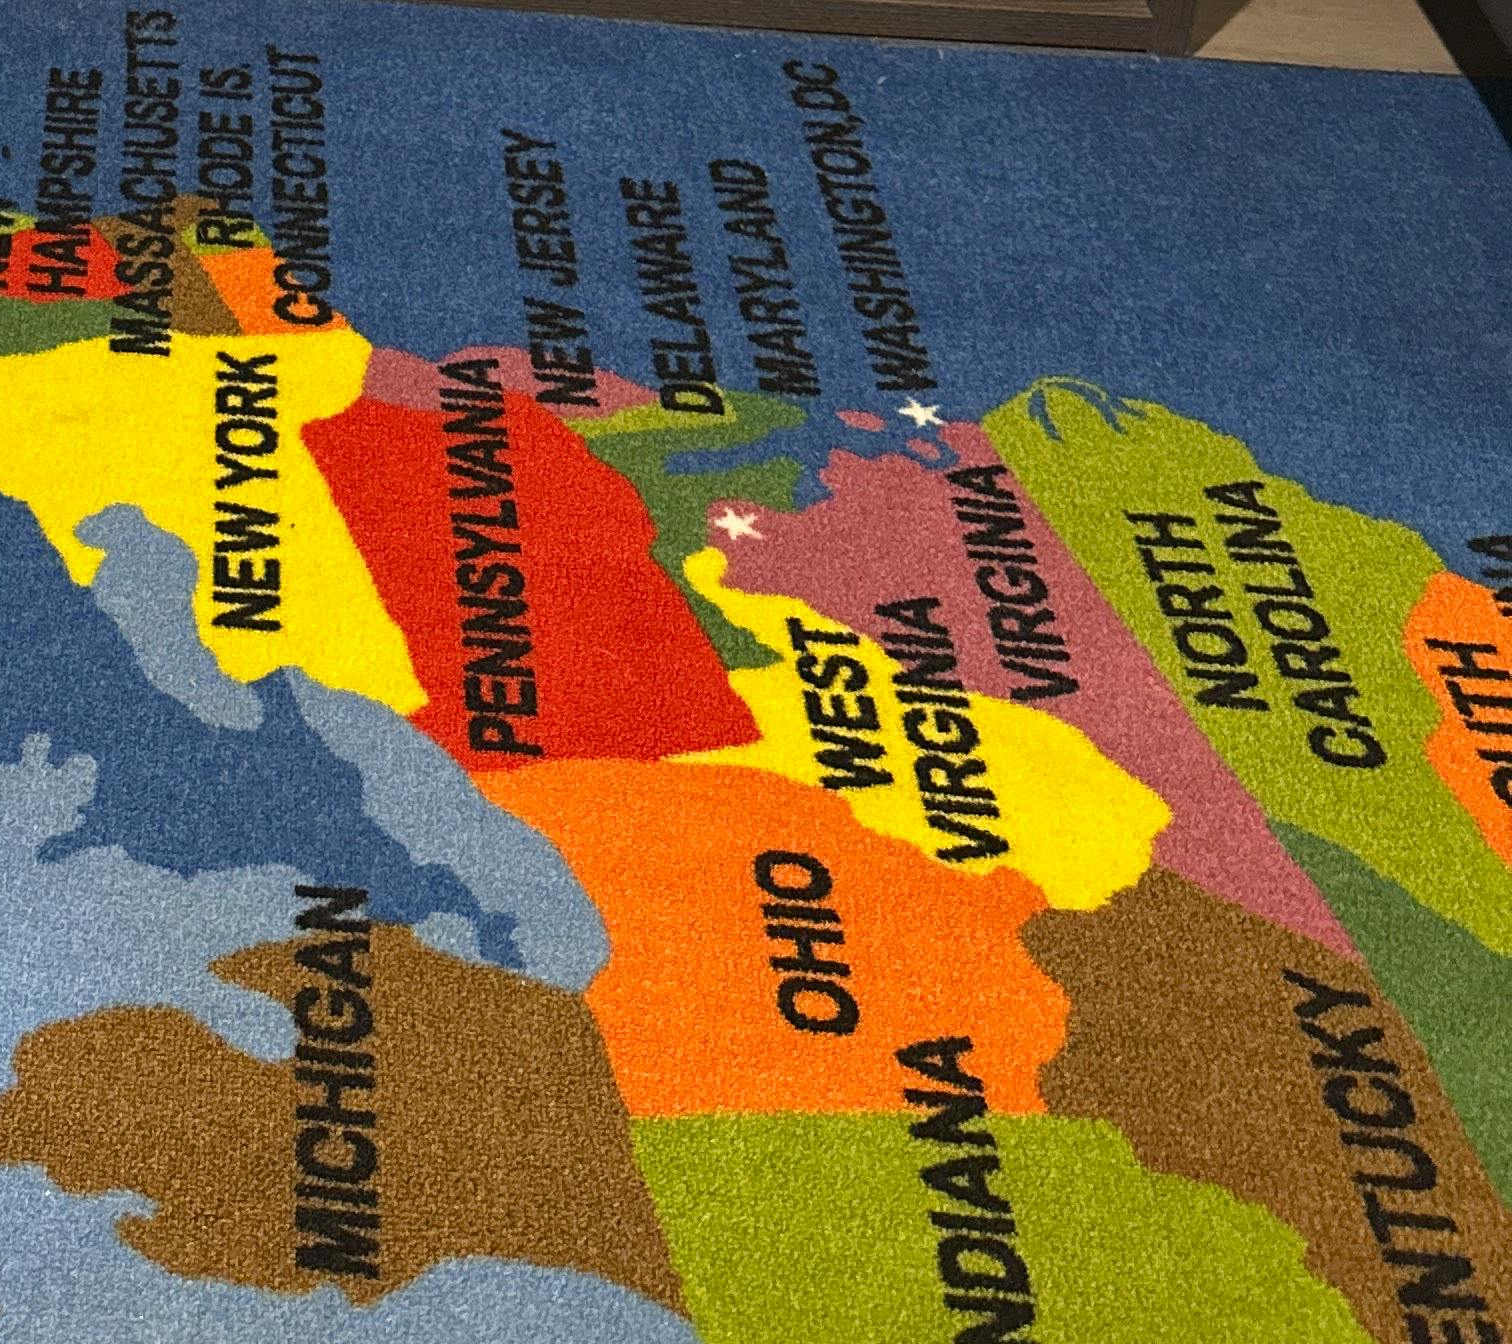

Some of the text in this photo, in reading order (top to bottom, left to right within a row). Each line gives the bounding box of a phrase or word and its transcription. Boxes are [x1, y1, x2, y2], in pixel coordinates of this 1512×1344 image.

[26, 67, 104, 297] HAMPSHIRE
[109, 10, 180, 357] MASSACHUSETTS
[196, 112, 254, 248] RHODE
[266, 43, 333, 326] CONNECTICUT
[501, 127, 600, 408] NEW JERSEY
[619, 176, 725, 416] DELAWARE
[708, 158, 821, 396] MARYLAND
[211, 352, 282, 632] NEW YORK
[439, 357, 544, 758] PENNSYLVANIA
[947, 464, 1081, 703] VIRGINIA
[1124, 510, 1270, 712] NORTH
[1203, 479, 1388, 770] CAROLINA
[786, 617, 894, 791] WEST
[874, 596, 1009, 864] VIRGINIA
[755, 847, 863, 1037] OHIO
[294, 884, 382, 1281] MICHIGAN
[894, 1036, 1037, 1344] NDIANA
